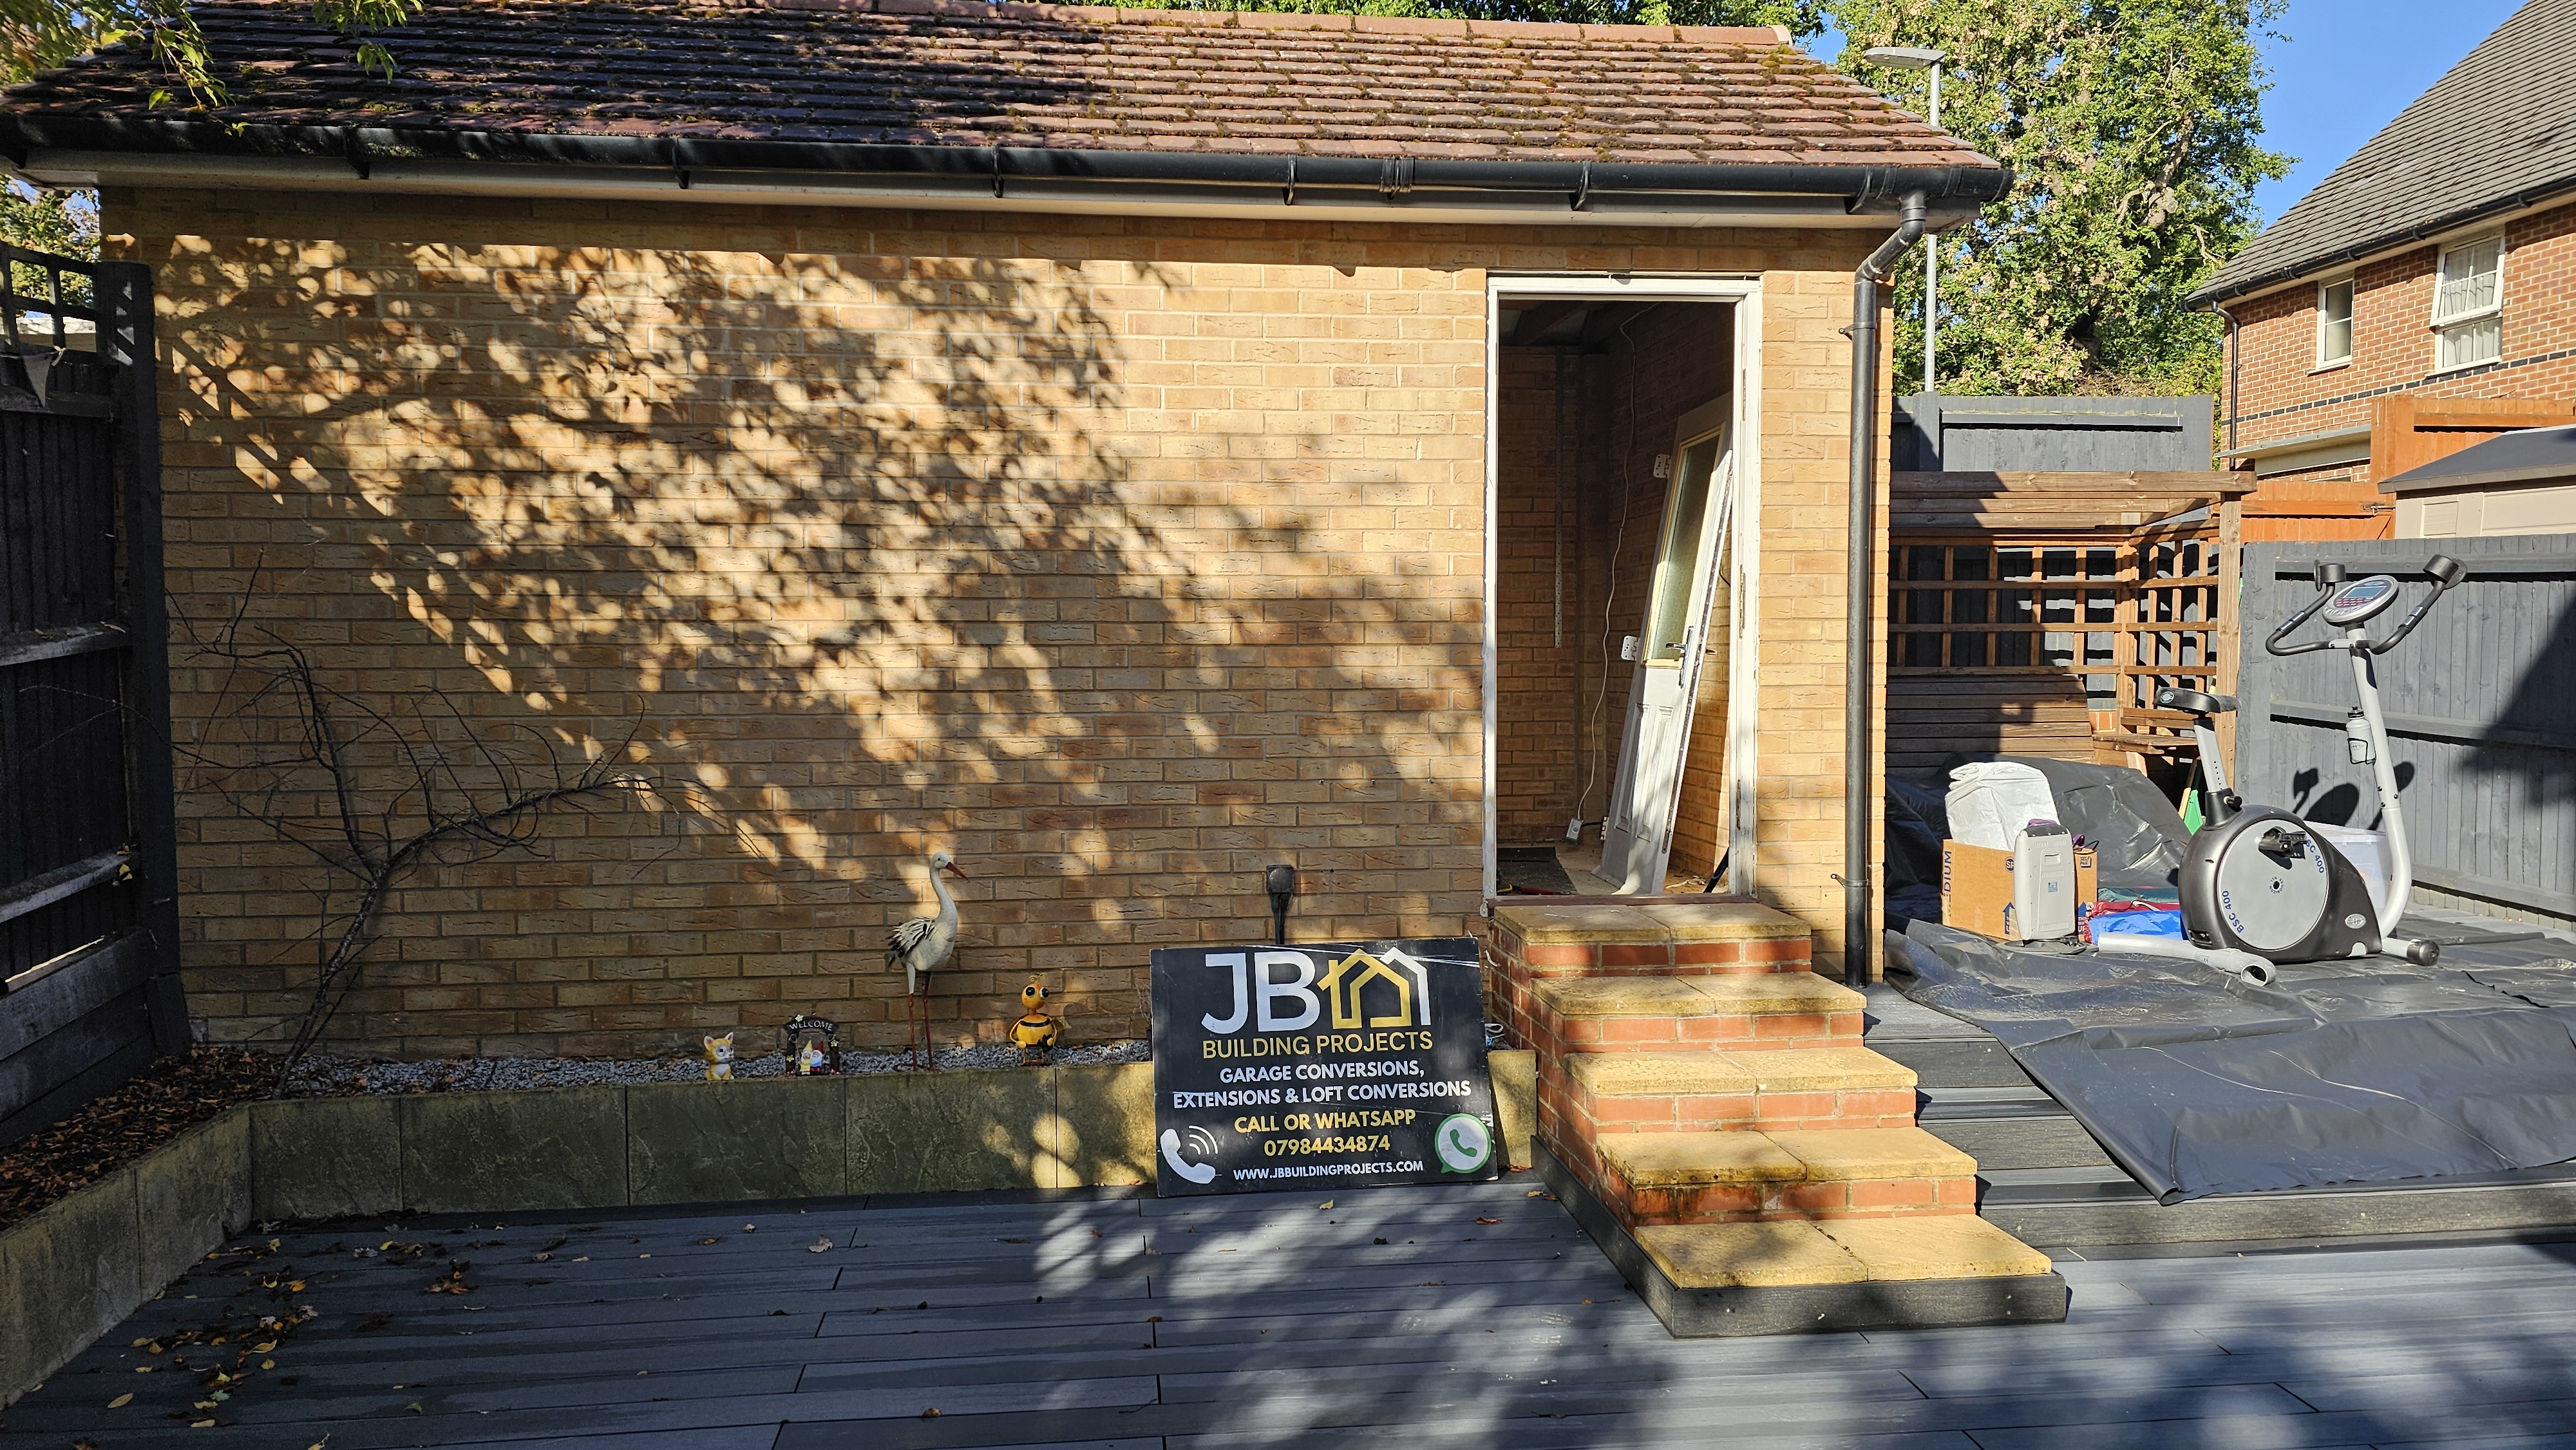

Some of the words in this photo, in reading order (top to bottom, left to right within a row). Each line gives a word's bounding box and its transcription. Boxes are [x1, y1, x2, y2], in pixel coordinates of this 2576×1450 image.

[2315, 855, 2325, 873] 400
[2222, 890, 2231, 910] 400
[2228, 912, 2245, 934] BSC
[1200, 950, 1320, 1035] JB
[789, 1020, 833, 1031] WELCOME
[1202, 1037, 1310, 1059] BUILDING
[1316, 1031, 1434, 1055] PROJECTS
[1220, 1066, 1292, 1084] GARAGE
[1295, 1060, 1425, 1080] CONVERSIONS,
[1173, 1089, 1281, 1109] EXTENSIONS
[1285, 1088, 1300, 1104] &
[1301, 1086, 1344, 1103] LOFT
[1347, 1080, 1472, 1101] CONVERSIONS
[1234, 1115, 1280, 1133] CALL
[1283, 1113, 1312, 1131] OR
[1313, 1109, 1416, 1130] WHATSAPP
[1264, 1135, 1390, 1156] 07984434874
[1233, 1160, 1424, 1180] WWW.JBBUILDINGPROJECTS.COM
